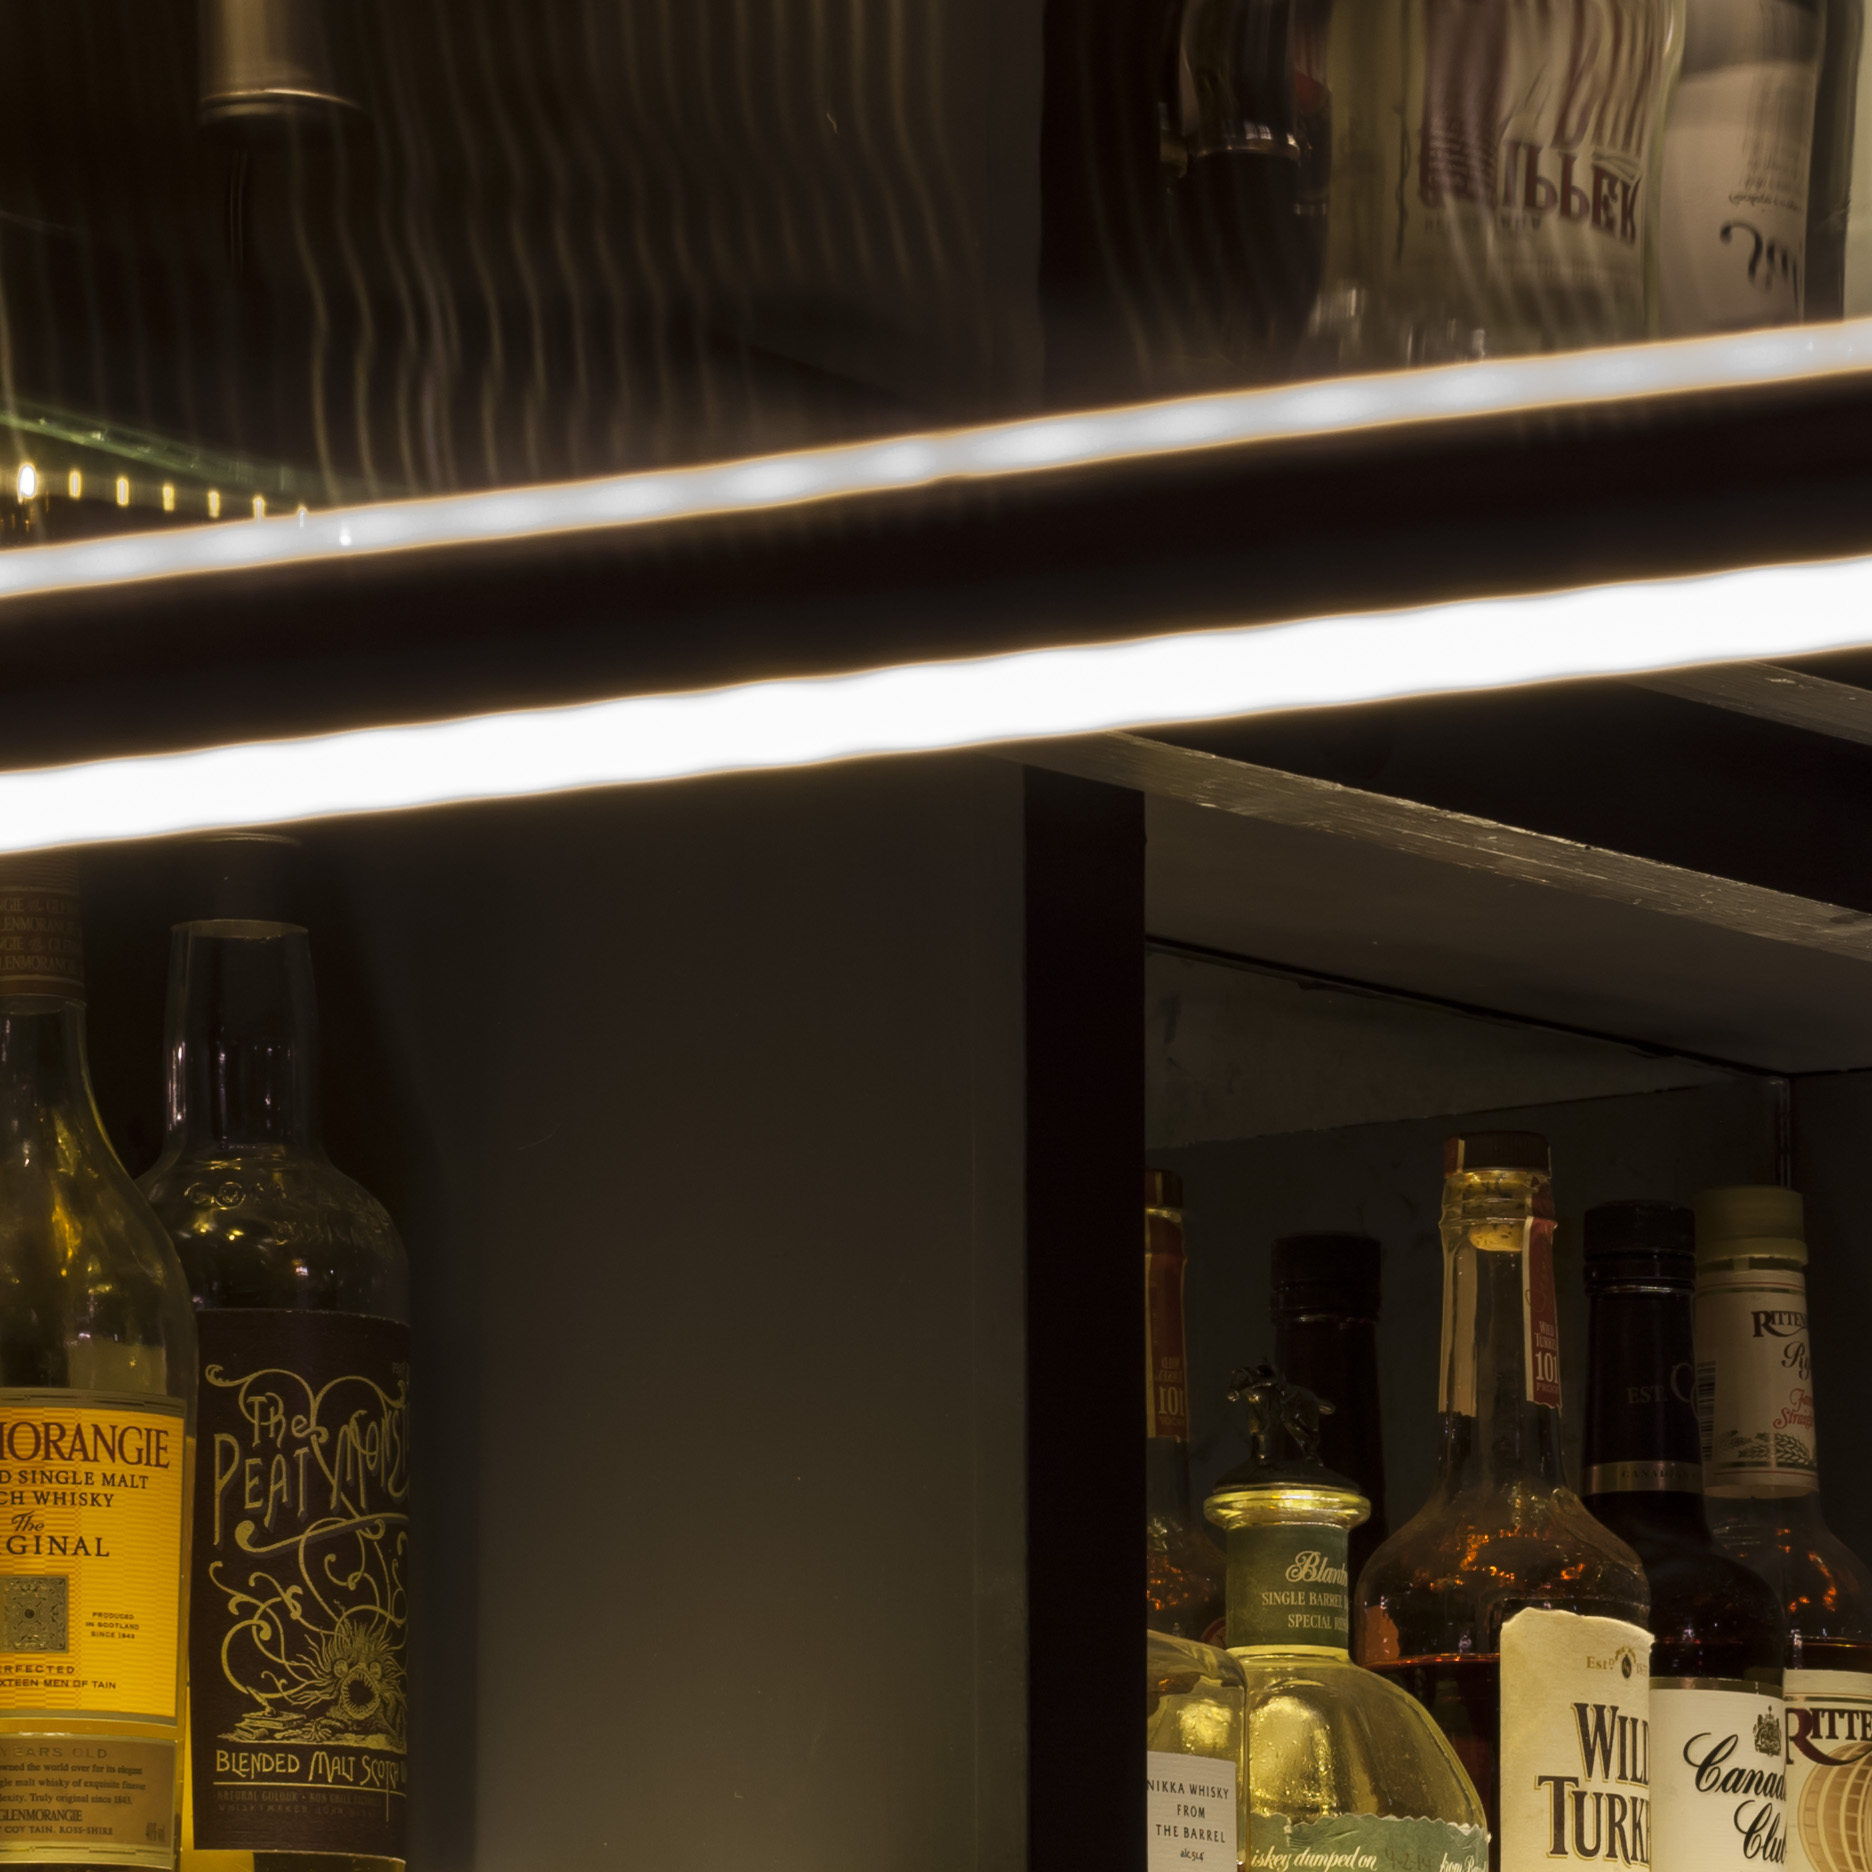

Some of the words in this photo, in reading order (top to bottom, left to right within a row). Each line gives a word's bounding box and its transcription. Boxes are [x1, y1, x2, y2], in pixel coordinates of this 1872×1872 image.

[1536, 1350, 1559, 1384] 101
[247, 1392, 313, 1448] The
[0, 1421, 170, 1469] ORANGIE
[18, 1469, 95, 1487] SINGLE
[102, 1472, 149, 1490] MALT
[213, 1432, 309, 1547] PEAT
[32, 1490, 115, 1508] WHISKY
[11, 1510, 45, 1533] The
[0, 1534, 110, 1558] GINAL
[1261, 1591, 1306, 1606] SINGLE
[1309, 1592, 1344, 1608] BARREL
[97, 1621, 140, 1631] SCOTLAND
[1287, 1614, 1333, 1630] SPECIAL
[44, 1679, 69, 1688] MEN
[216, 1749, 301, 1780] BLENDED
[307, 1750, 357, 1784] MALT
[1147, 1779, 1185, 1795] NIKKA
[1189, 1782, 1230, 1800] WHISKY
[1177, 1803, 1206, 1819] FROM
[1156, 1823, 1179, 1838] THE
[1184, 1826, 1226, 1844] BARREL
